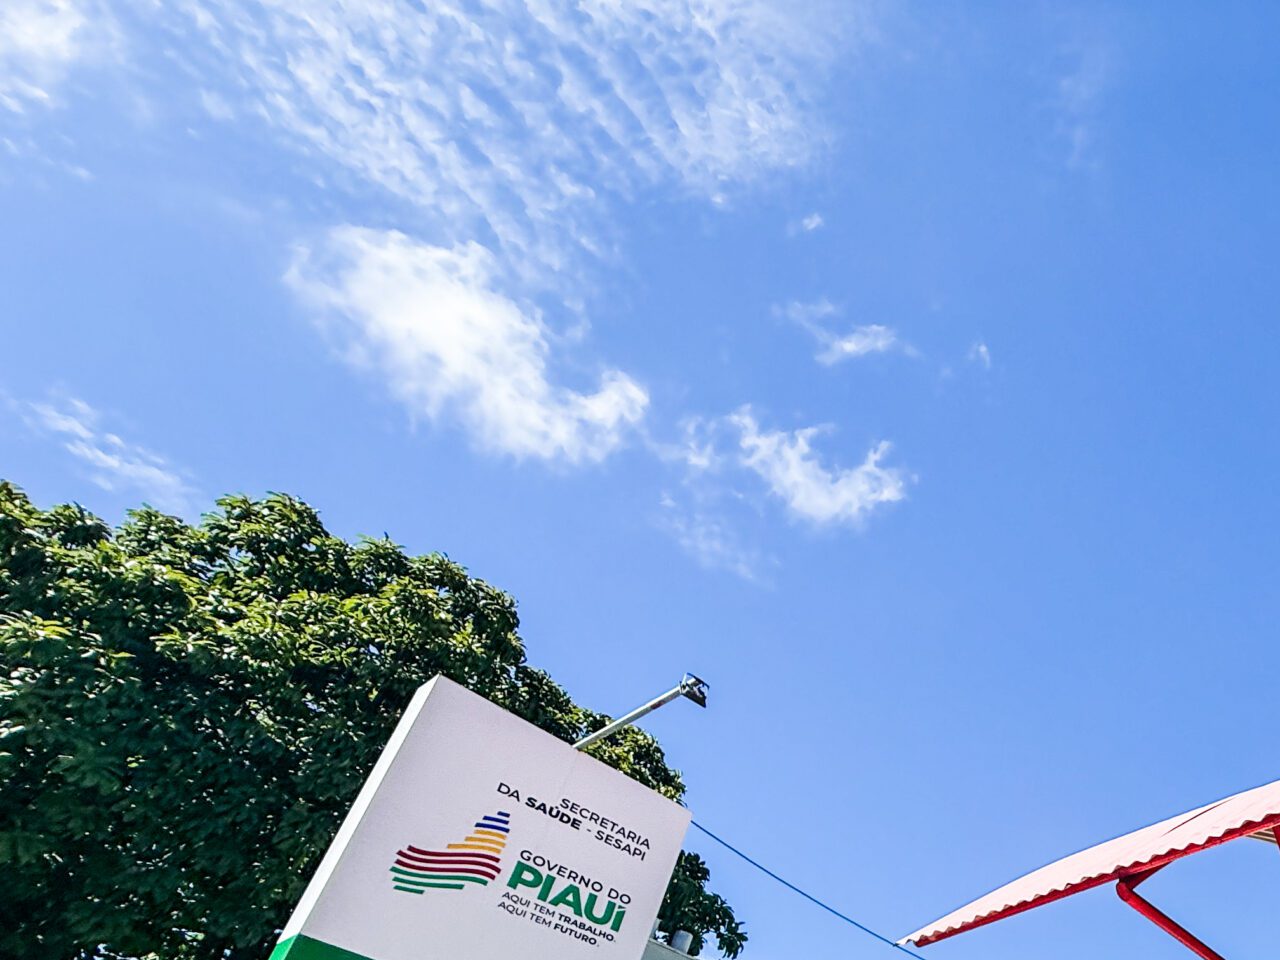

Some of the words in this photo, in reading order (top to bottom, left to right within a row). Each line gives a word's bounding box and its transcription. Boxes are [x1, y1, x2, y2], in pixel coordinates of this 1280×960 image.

[497, 782, 521, 802] DA
[525, 796, 582, 830] SAÚDE
[594, 829, 647, 861] SESAPI
[559, 798, 651, 850] SECRETARIA
[506, 860, 627, 933] PIAUÍ
[520, 849, 603, 892] GOVERNO
[607, 887, 632, 905] DO
[497, 901, 527, 918] AQUI
[529, 912, 552, 928] TEM
[553, 922, 600, 947] FUTURO.
[502, 891, 531, 908] AQUI
[533, 902, 556, 918] TEM
[558, 912, 616, 943] TRABALHO.
